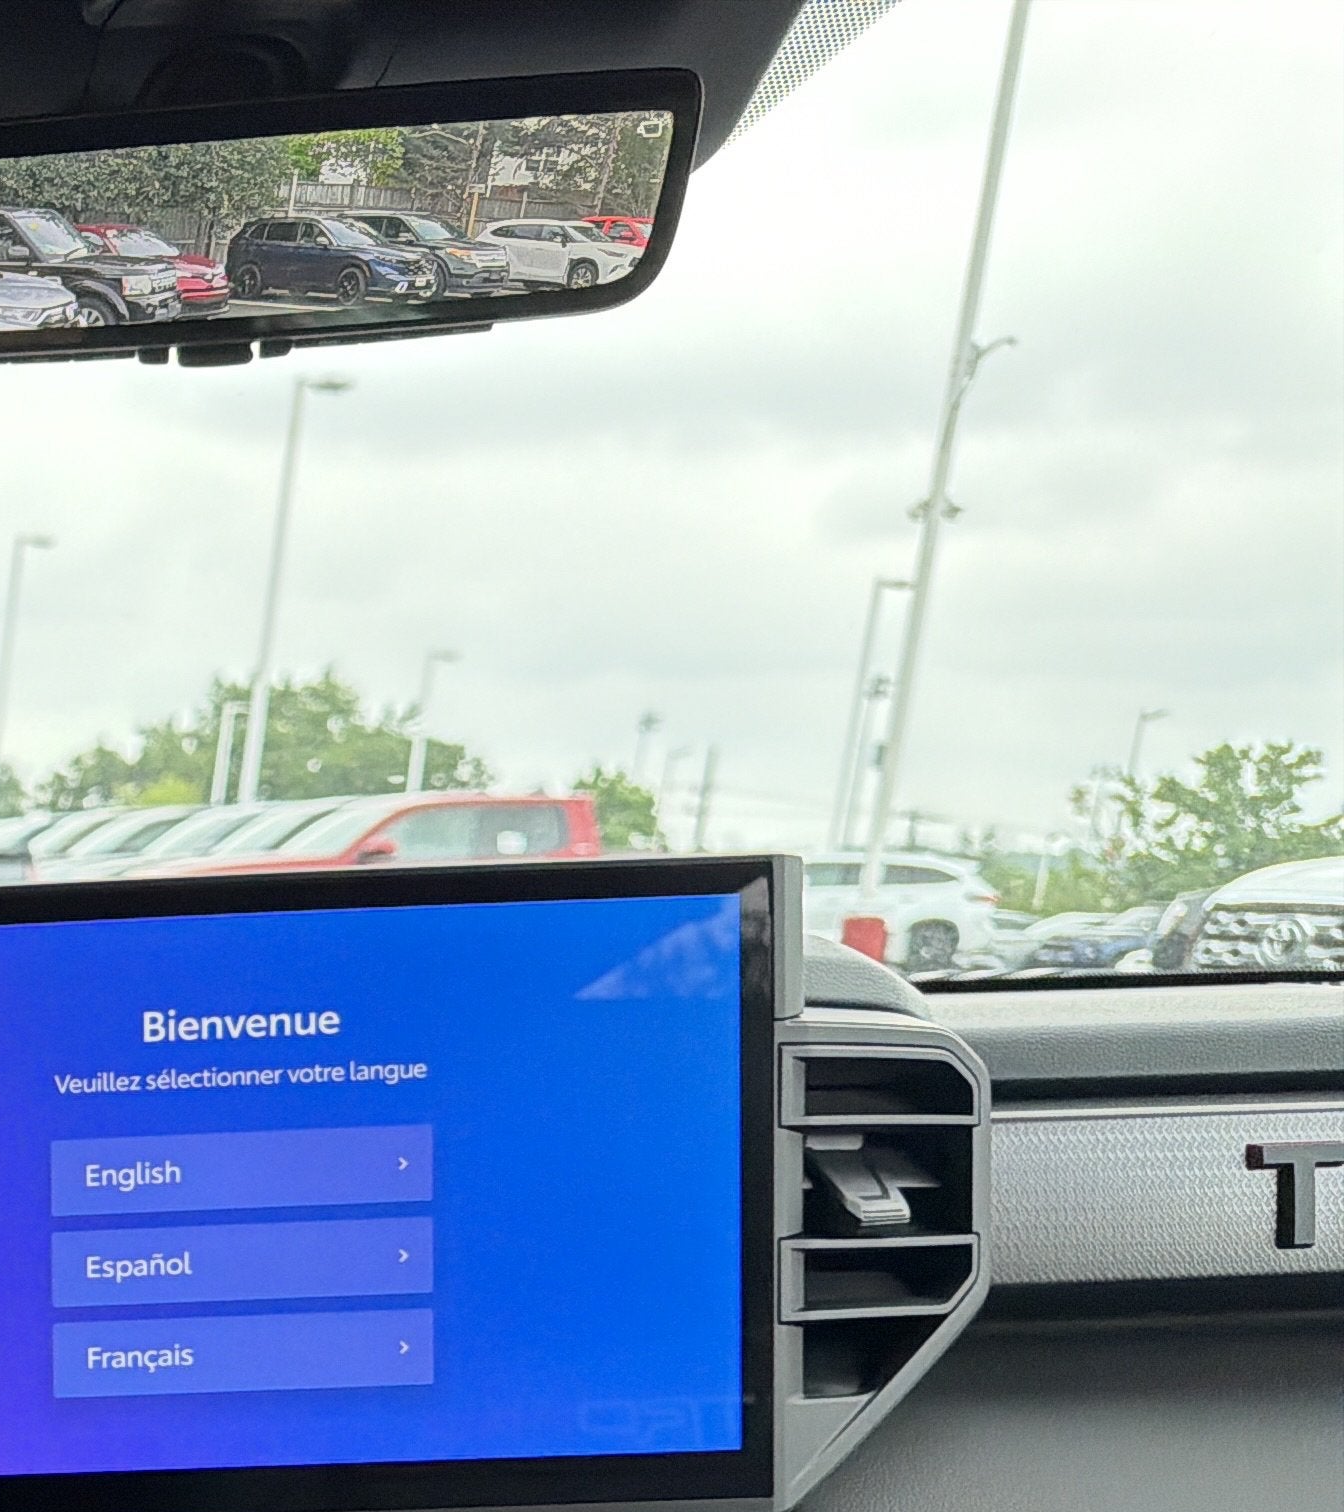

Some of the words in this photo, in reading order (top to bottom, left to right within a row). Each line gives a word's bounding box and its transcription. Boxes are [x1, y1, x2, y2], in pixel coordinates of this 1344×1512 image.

[142, 1008, 341, 1043] Bienvenue
[54, 1071, 142, 1095] Veuillez
[145, 1067, 283, 1091] sélectionner
[286, 1064, 346, 1084] votre
[348, 1060, 428, 1086] langue
[85, 1159, 181, 1192] English
[86, 1250, 193, 1284] Español
[87, 1343, 194, 1374] Français
